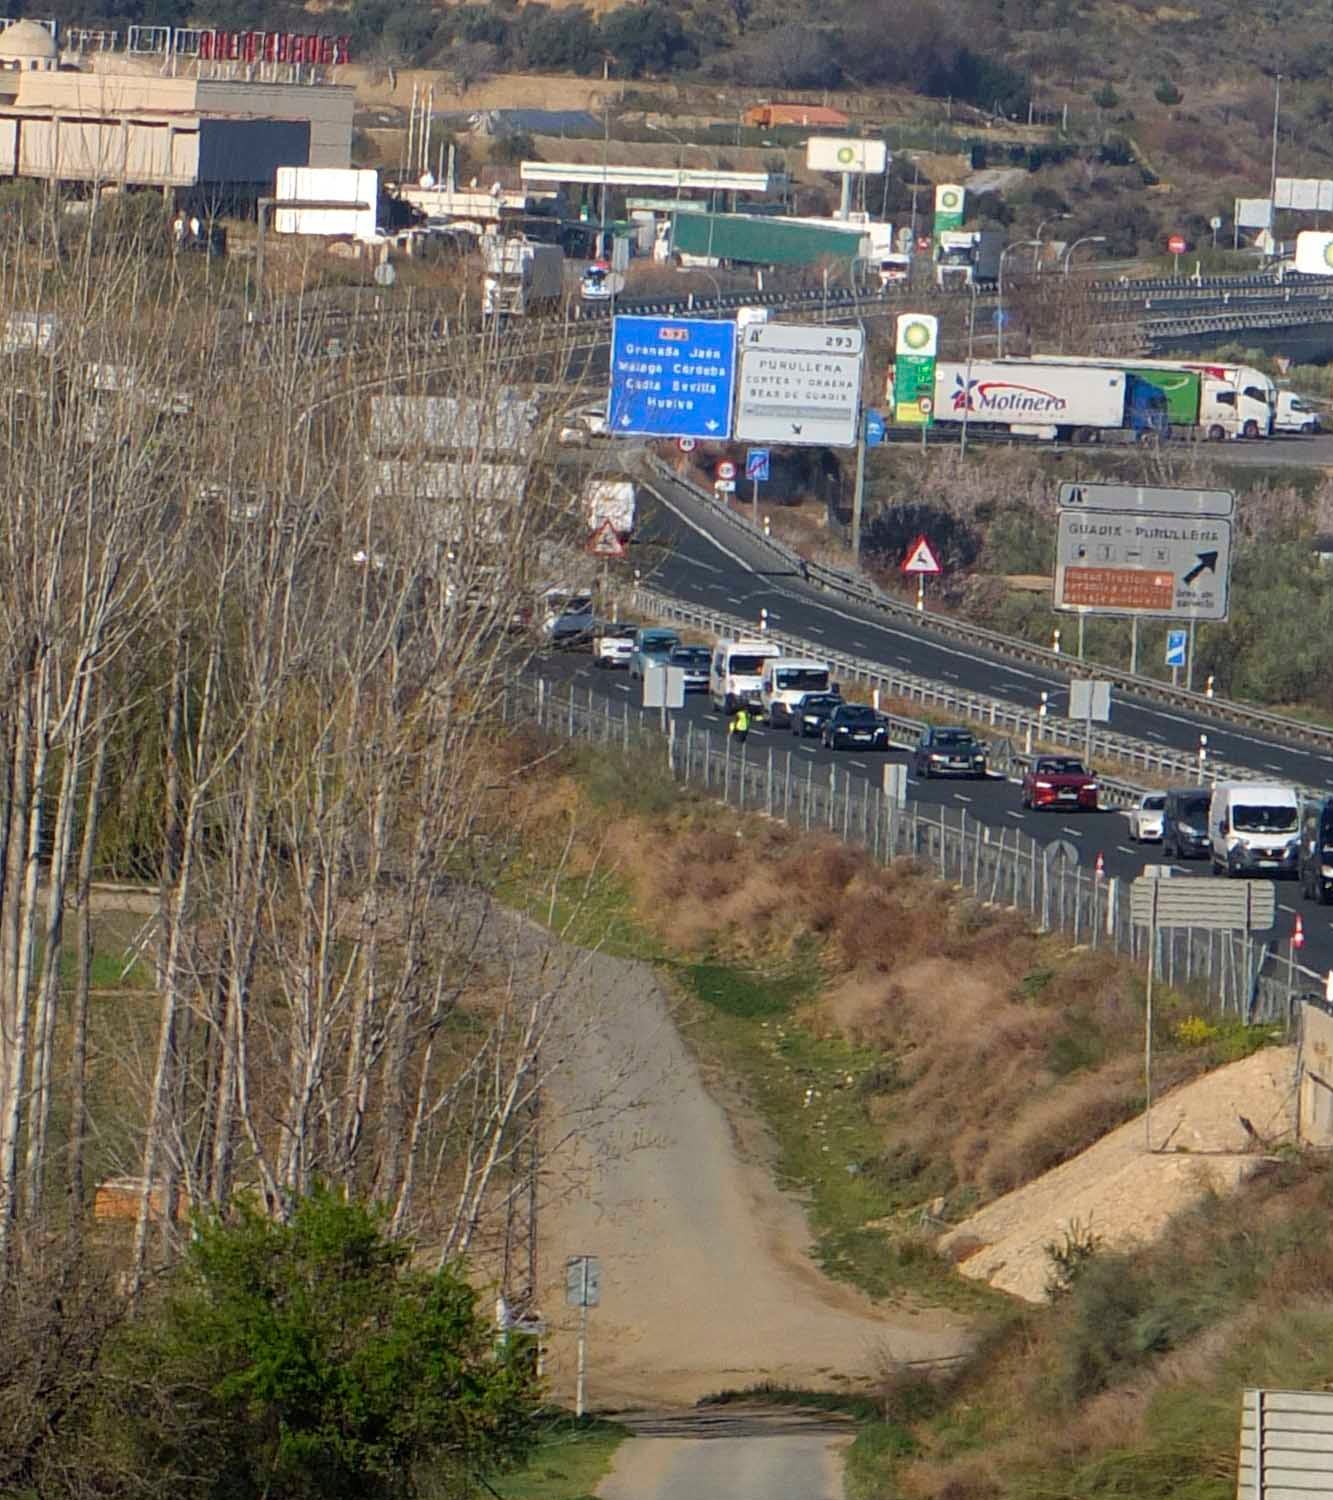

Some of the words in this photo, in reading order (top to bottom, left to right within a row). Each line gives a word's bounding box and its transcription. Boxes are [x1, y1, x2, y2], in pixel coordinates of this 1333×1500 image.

[824, 336, 853, 349] 293
[759, 359, 843, 374] PURULLENA
[978, 393, 1066, 412] Molinero
[1068, 523, 1122, 537] GUADIX
[1135, 527, 1220, 542] PURULLENA
